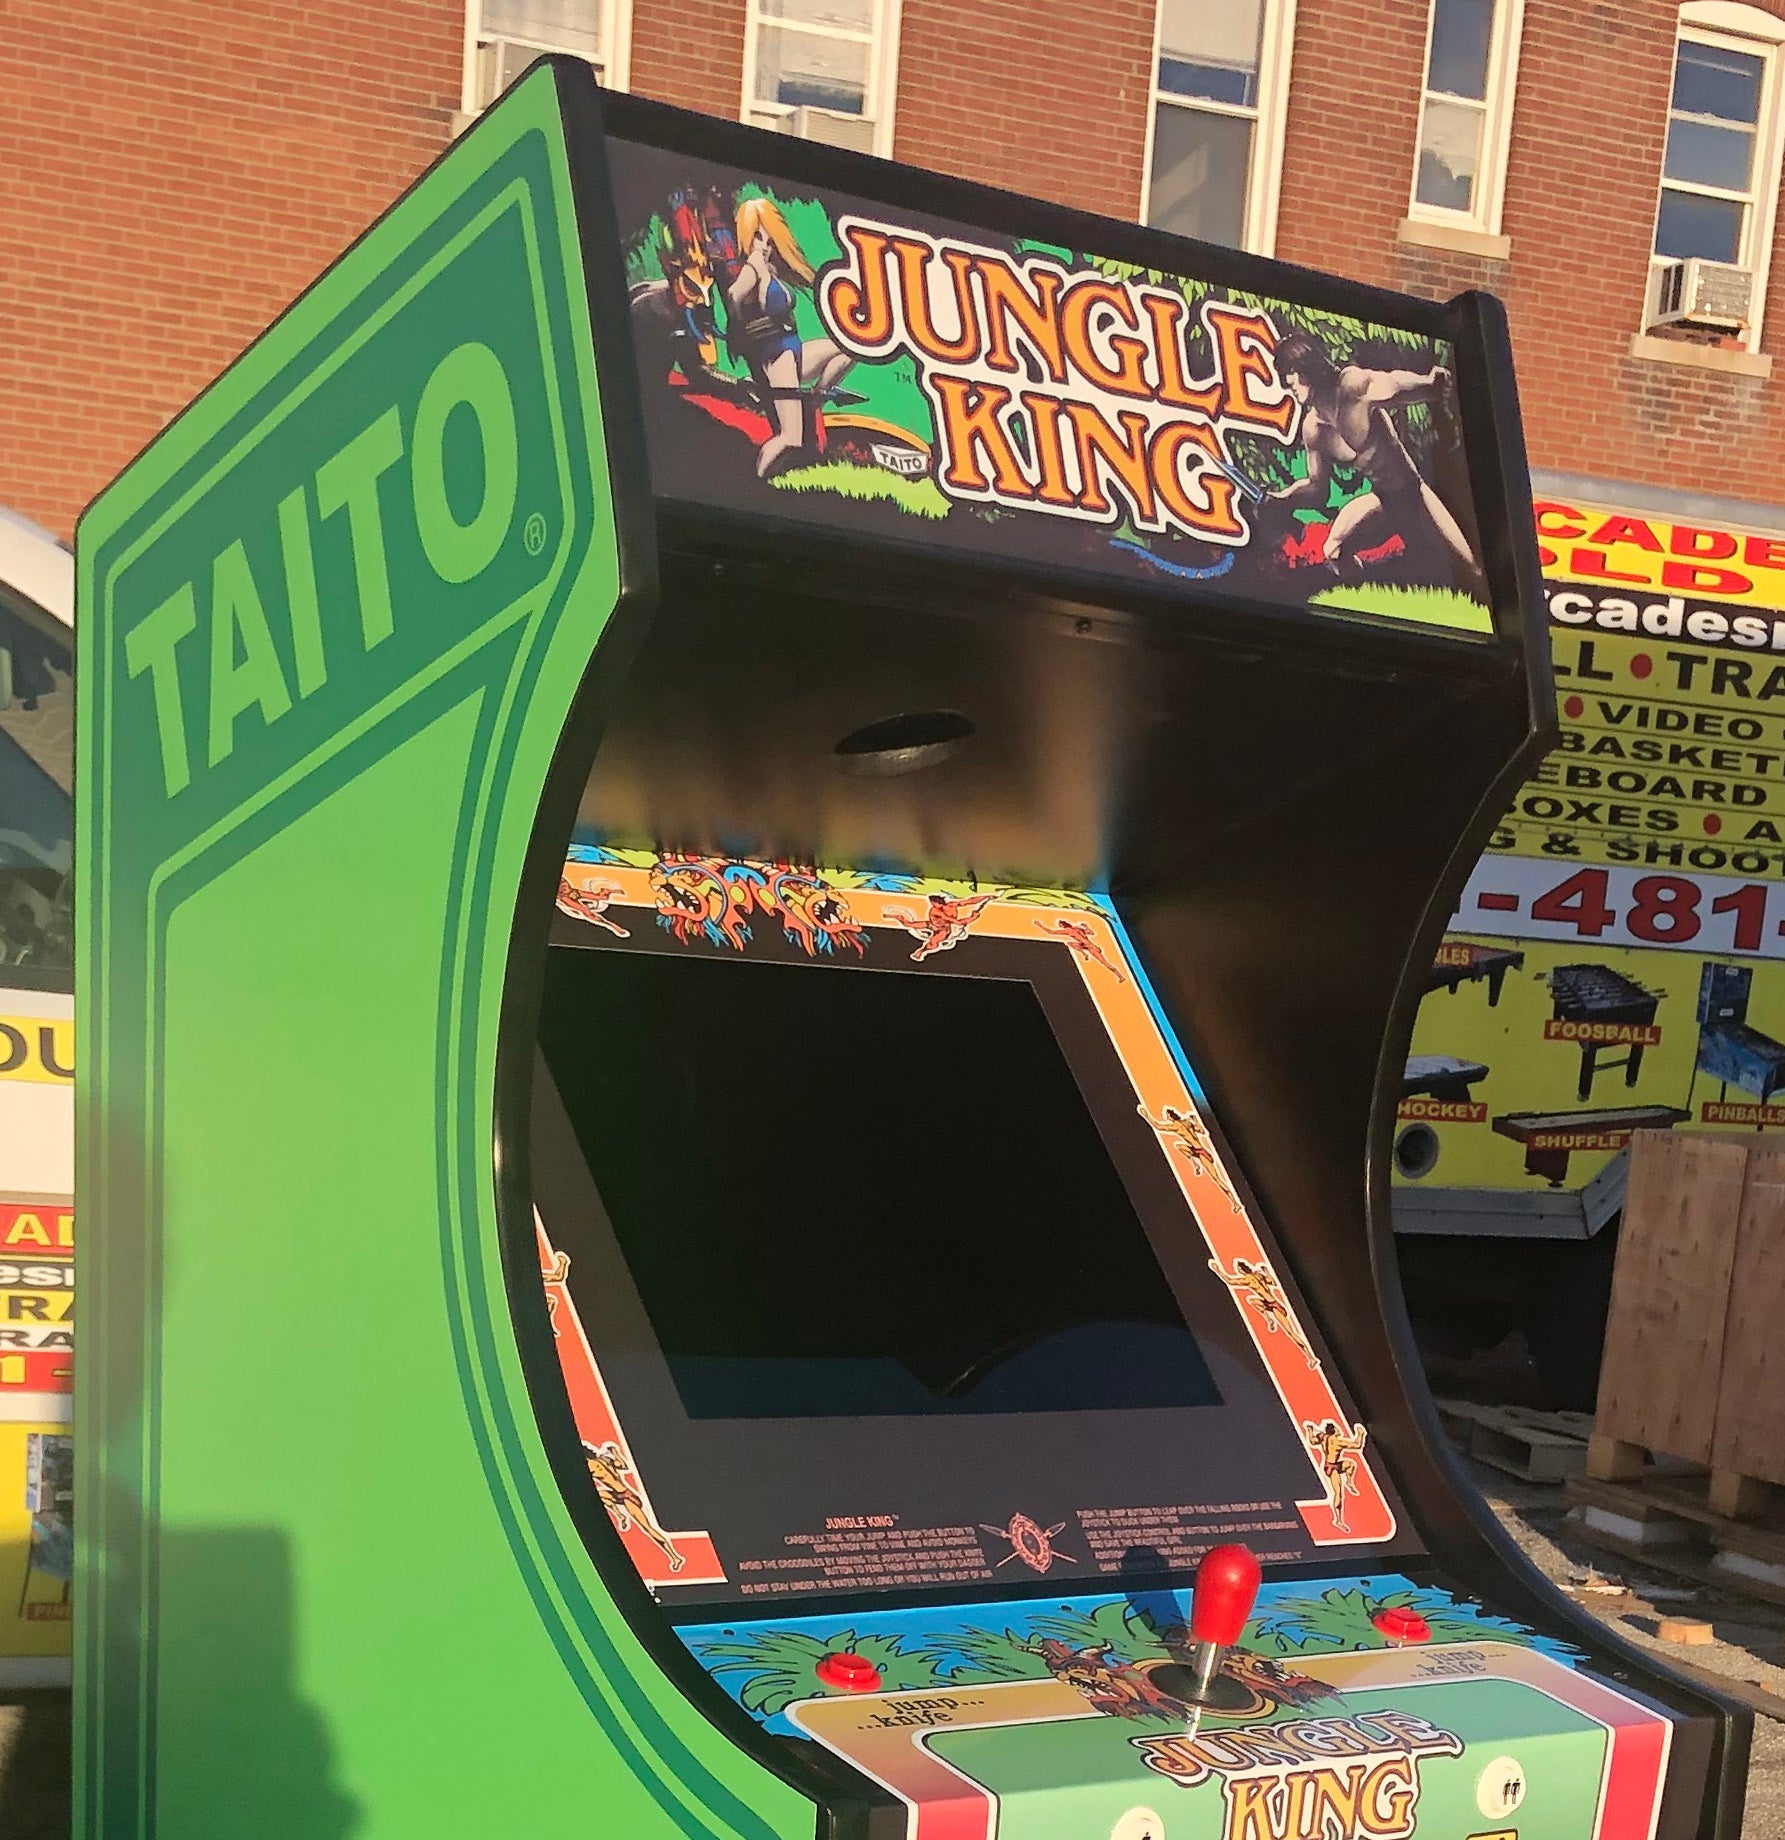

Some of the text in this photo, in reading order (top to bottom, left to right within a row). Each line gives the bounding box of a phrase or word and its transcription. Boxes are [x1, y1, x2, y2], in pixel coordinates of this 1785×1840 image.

[828, 226, 1297, 434] JUNGLE
[879, 452, 922, 470] TAITO
[930, 373, 1247, 537] KING
[125, 342, 518, 800] TAITO
[1544, 588, 1785, 650] cades
[1598, 701, 1763, 740] VIDEO
[1560, 730, 1785, 776] BASKET
[1506, 796, 1679, 831] OXES
[1541, 832, 1580, 856] &
[1549, 1022, 1656, 1043] FOOSBALL
[1398, 1103, 1483, 1118] HOCKEY
[1534, 1134, 1622, 1148] SHUFFLE
[825, 1516, 866, 1529] JUNGLE
[866, 1515, 893, 1528] KING
[858, 1710, 953, 1727] ...knife
[881, 1697, 985, 1714] jump...
[1138, 1712, 1457, 1777] JUNGLE
